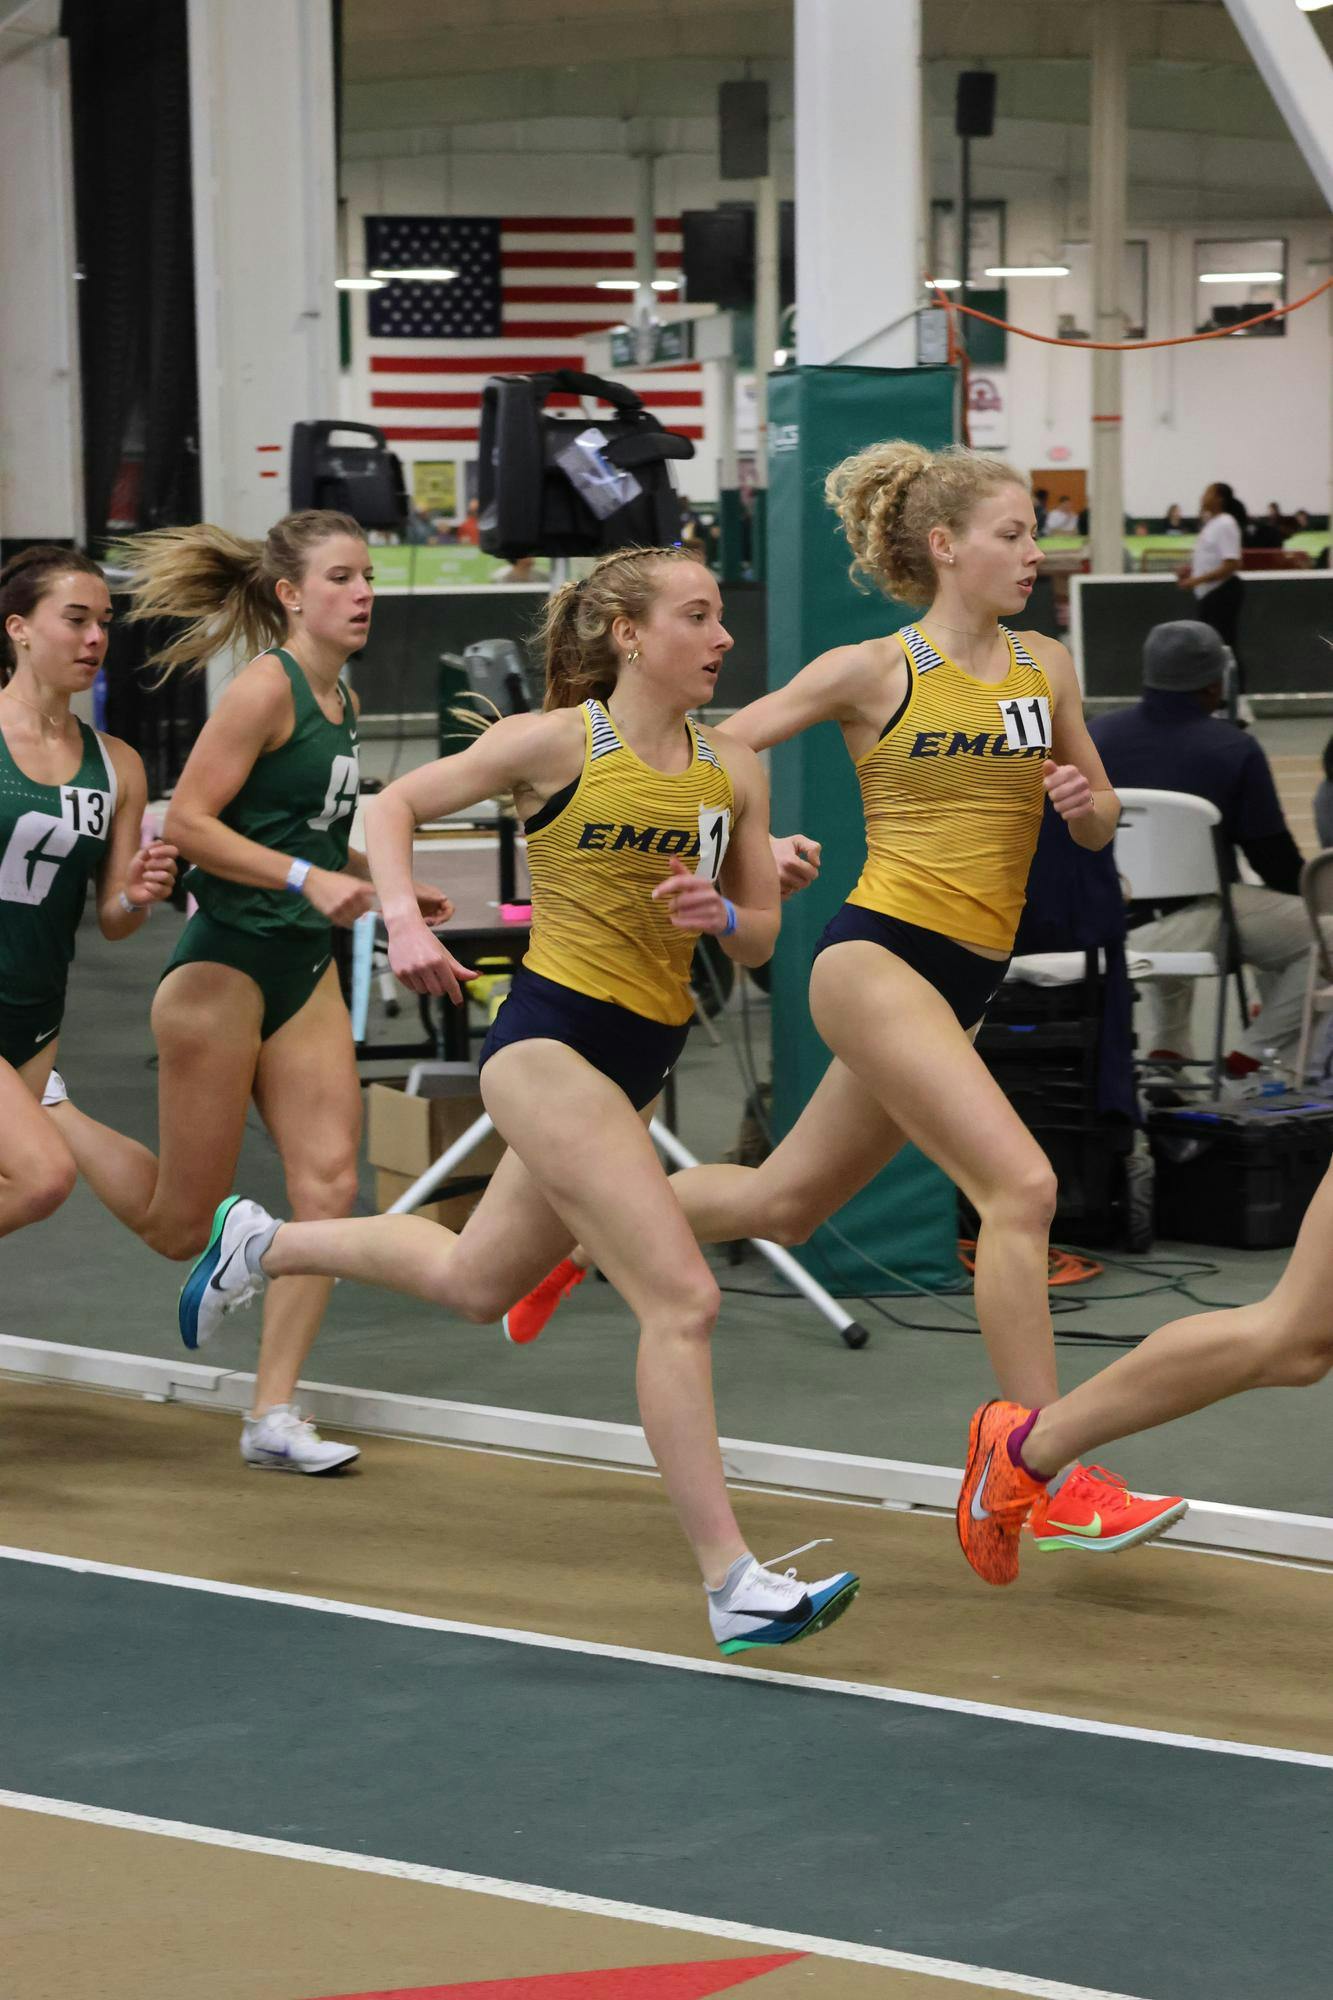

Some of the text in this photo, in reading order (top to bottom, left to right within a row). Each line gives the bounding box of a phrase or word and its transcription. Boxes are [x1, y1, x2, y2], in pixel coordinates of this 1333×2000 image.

[909, 731, 1052, 759] EMO
[1006, 699, 1046, 746] 11
[65, 789, 104, 835] 13
